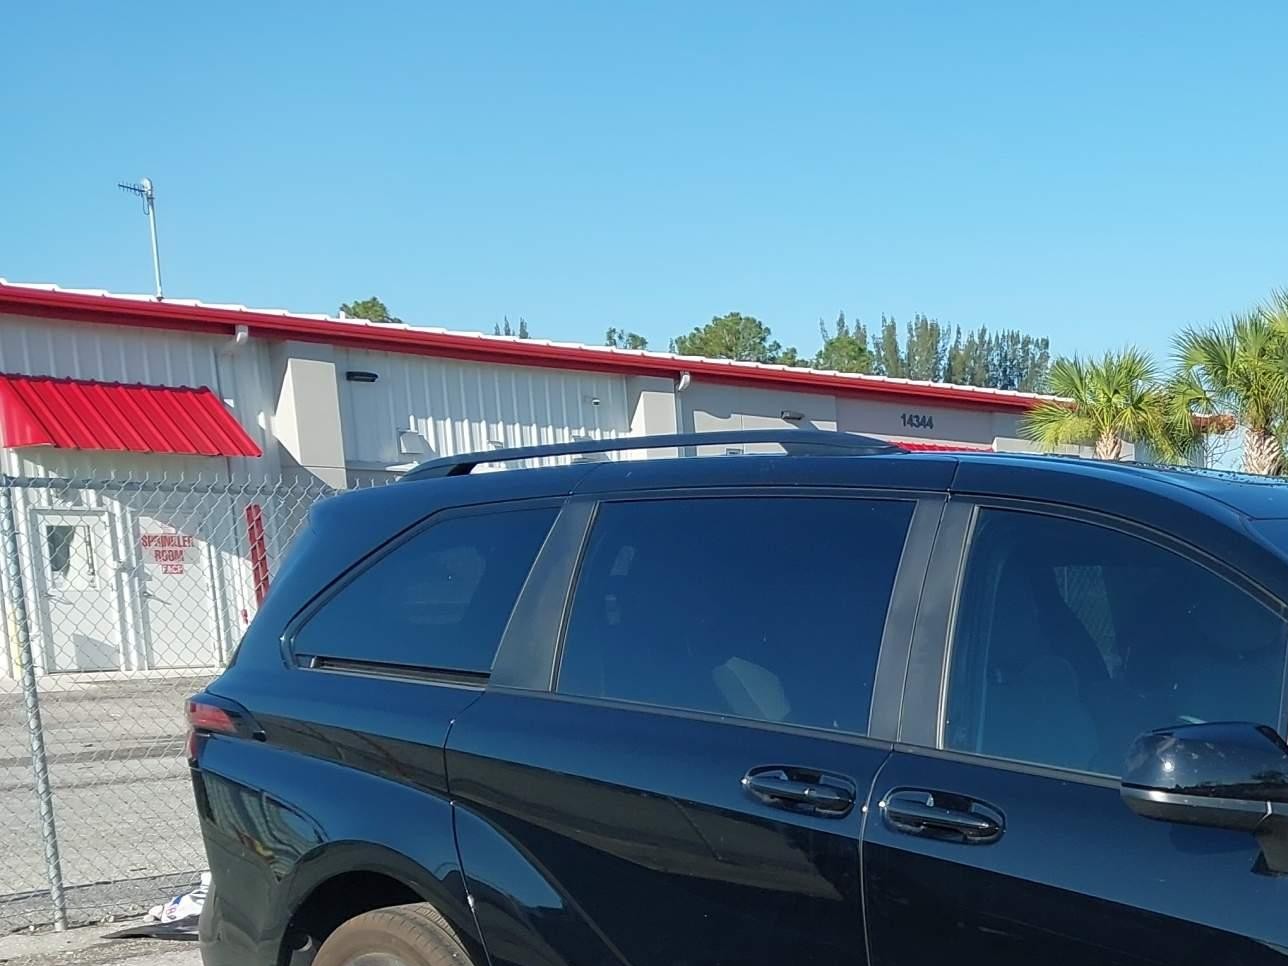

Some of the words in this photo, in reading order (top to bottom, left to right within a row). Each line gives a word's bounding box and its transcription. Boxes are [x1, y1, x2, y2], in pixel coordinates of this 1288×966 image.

[901, 413, 934, 430] 14344
[141, 535, 194, 548] SPRINKLER
[154, 549, 185, 562] ROOM
